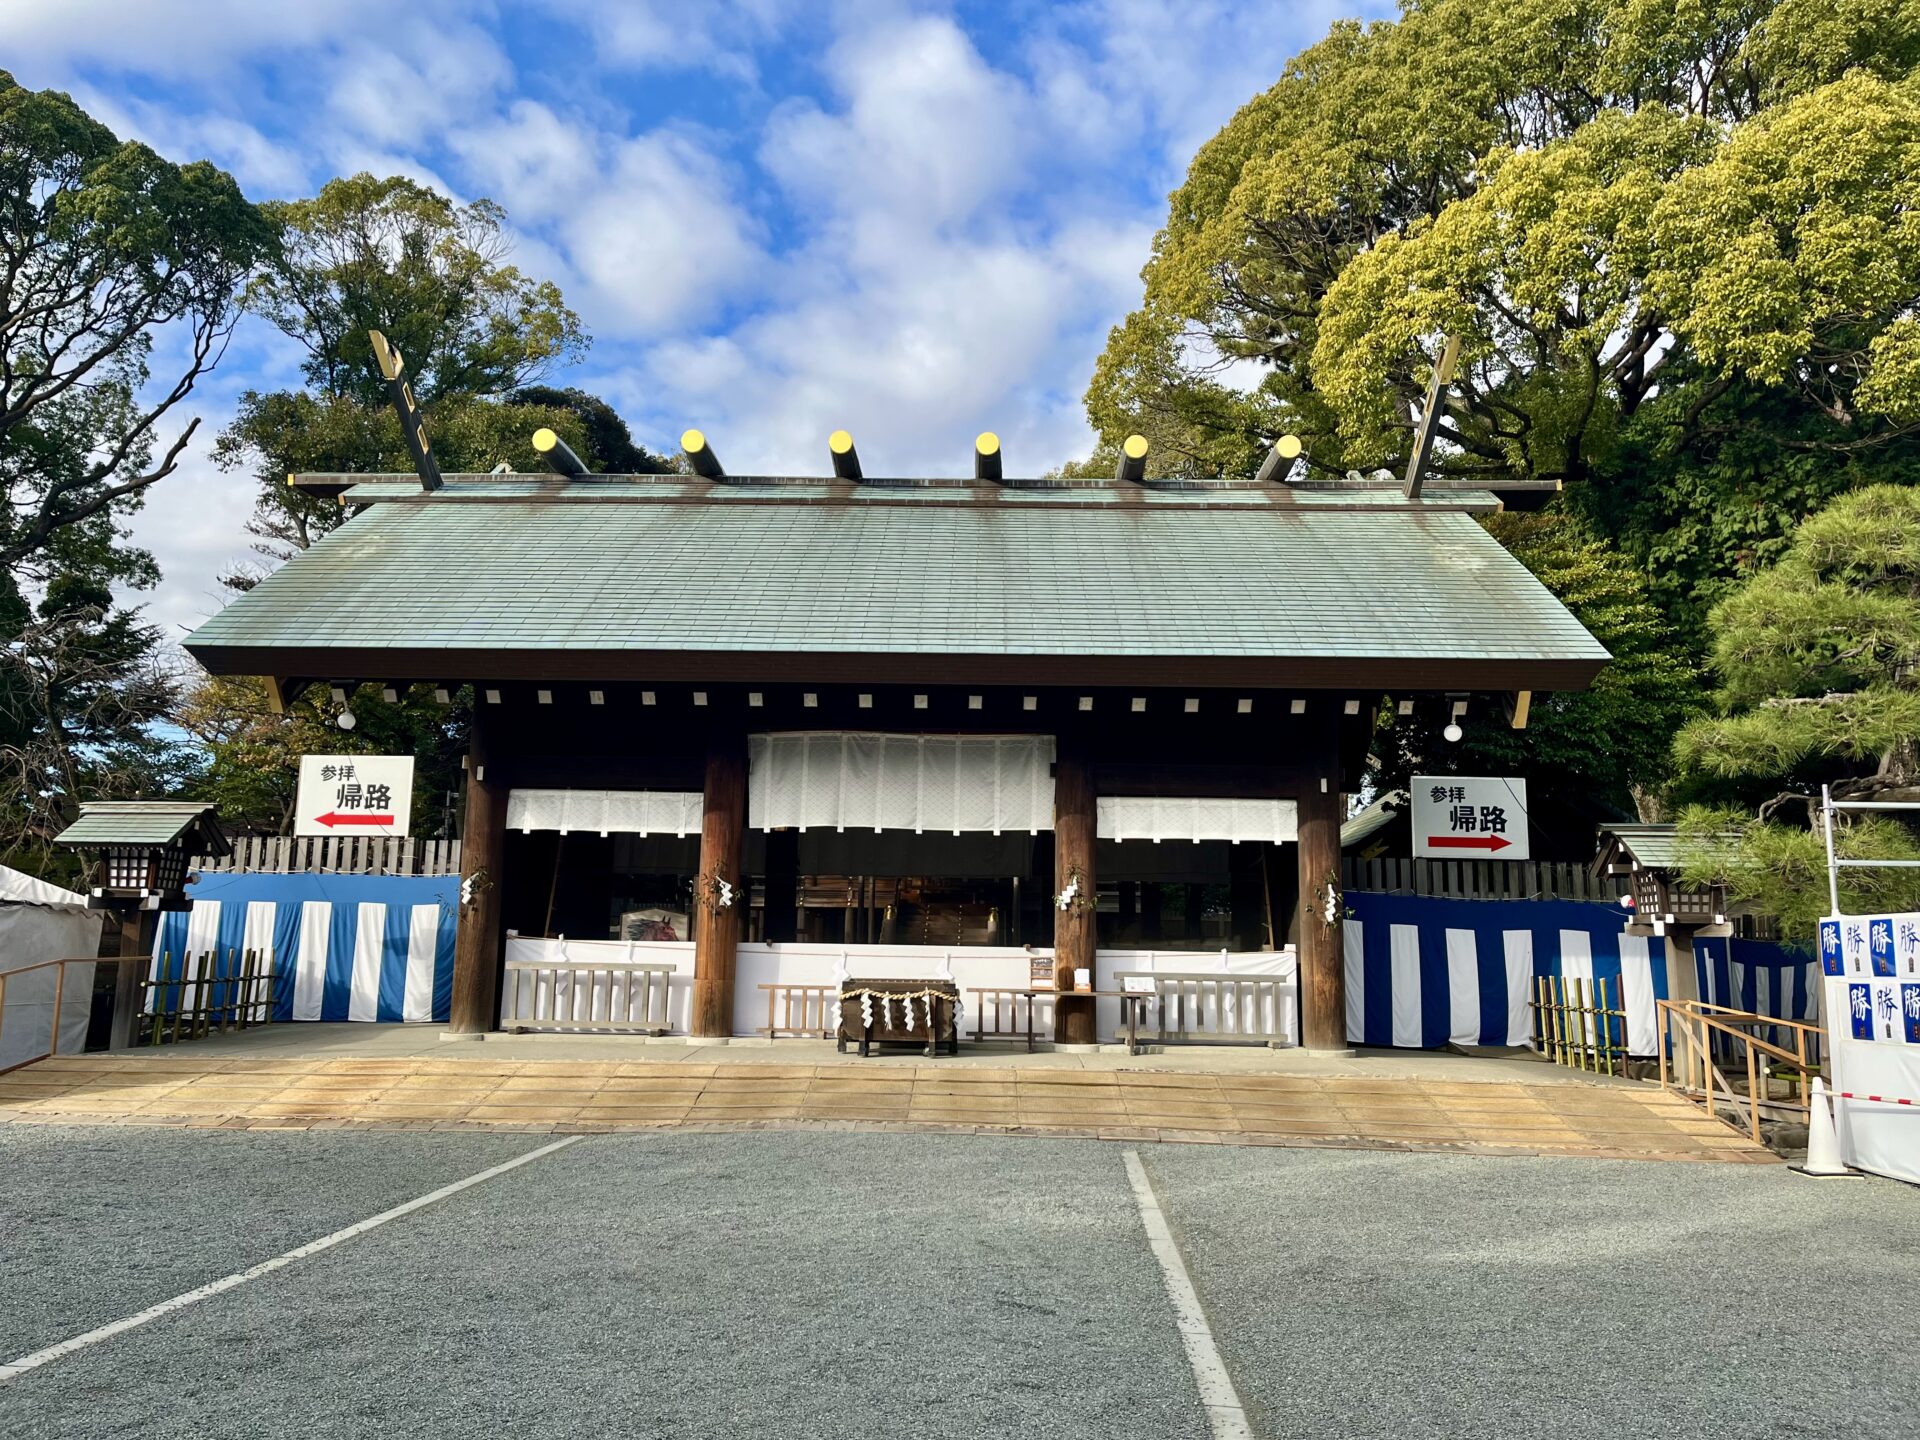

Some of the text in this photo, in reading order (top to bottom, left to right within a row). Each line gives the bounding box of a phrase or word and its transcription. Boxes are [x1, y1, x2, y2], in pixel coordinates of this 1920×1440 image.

[321, 765, 355, 782] 参拝
[336, 783, 392, 810] 帰路
[1430, 786, 1466, 803] 参拝
[1449, 805, 1508, 833] 帰路
[1822, 924, 1841, 955] 勝
[1846, 923, 1865, 954] 勝
[1871, 922, 1893, 955] 勝
[1900, 922, 1920, 954] 勝
[1850, 986, 1872, 1021] 勝
[1876, 986, 1898, 1022] 勝
